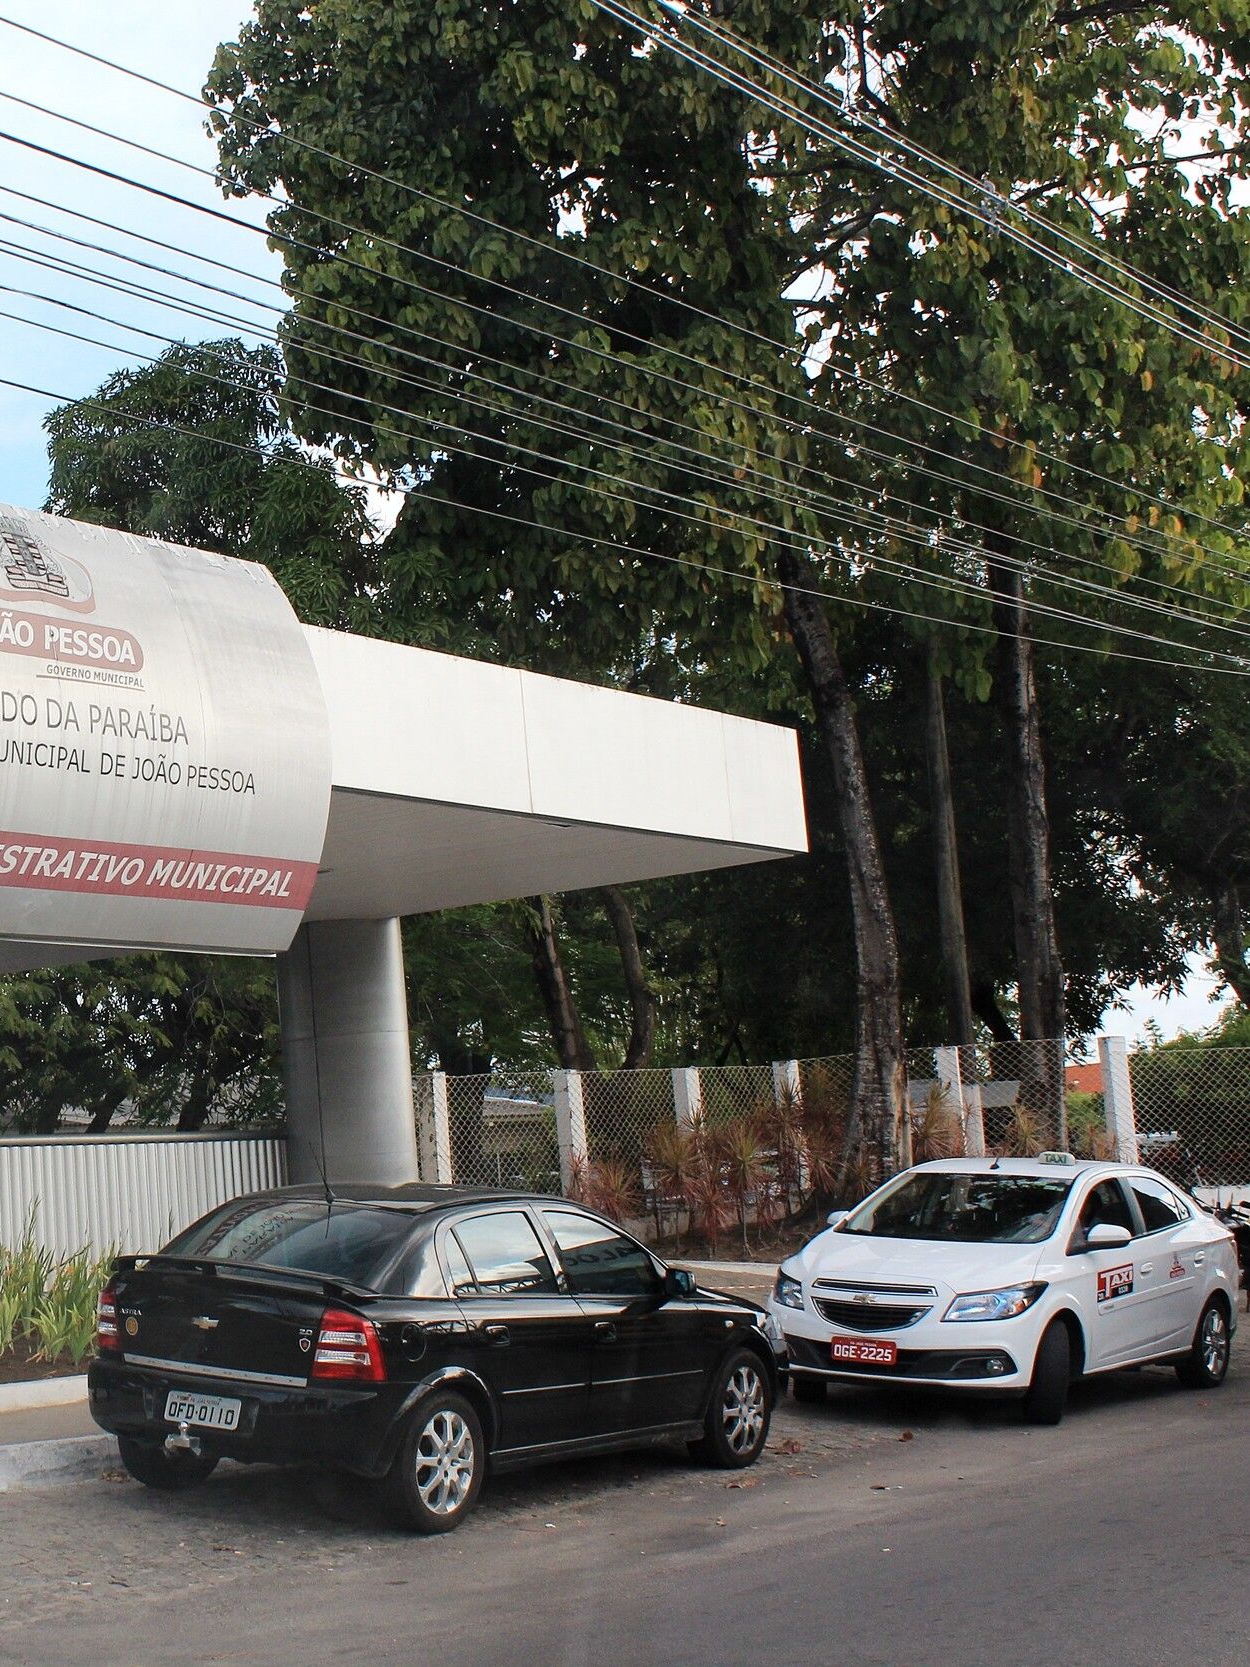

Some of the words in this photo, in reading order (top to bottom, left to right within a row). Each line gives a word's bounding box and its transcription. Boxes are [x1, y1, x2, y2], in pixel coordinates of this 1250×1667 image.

[44, 624, 137, 666] PESSOA
[46, 664, 92, 680] GOVERNO
[93, 671, 145, 688] MUNICIPAL
[46, 697, 80, 732] DA
[89, 704, 189, 745] PARAÍBA
[100, 752, 126, 778] DE
[131, 753, 182, 785] JOÃO
[186, 765, 256, 795] PESSOA
[146, 859, 294, 897] MUNICIPAL
[1044, 1153, 1067, 1164] TAXI
[1100, 1265, 1134, 1298] TAXI
